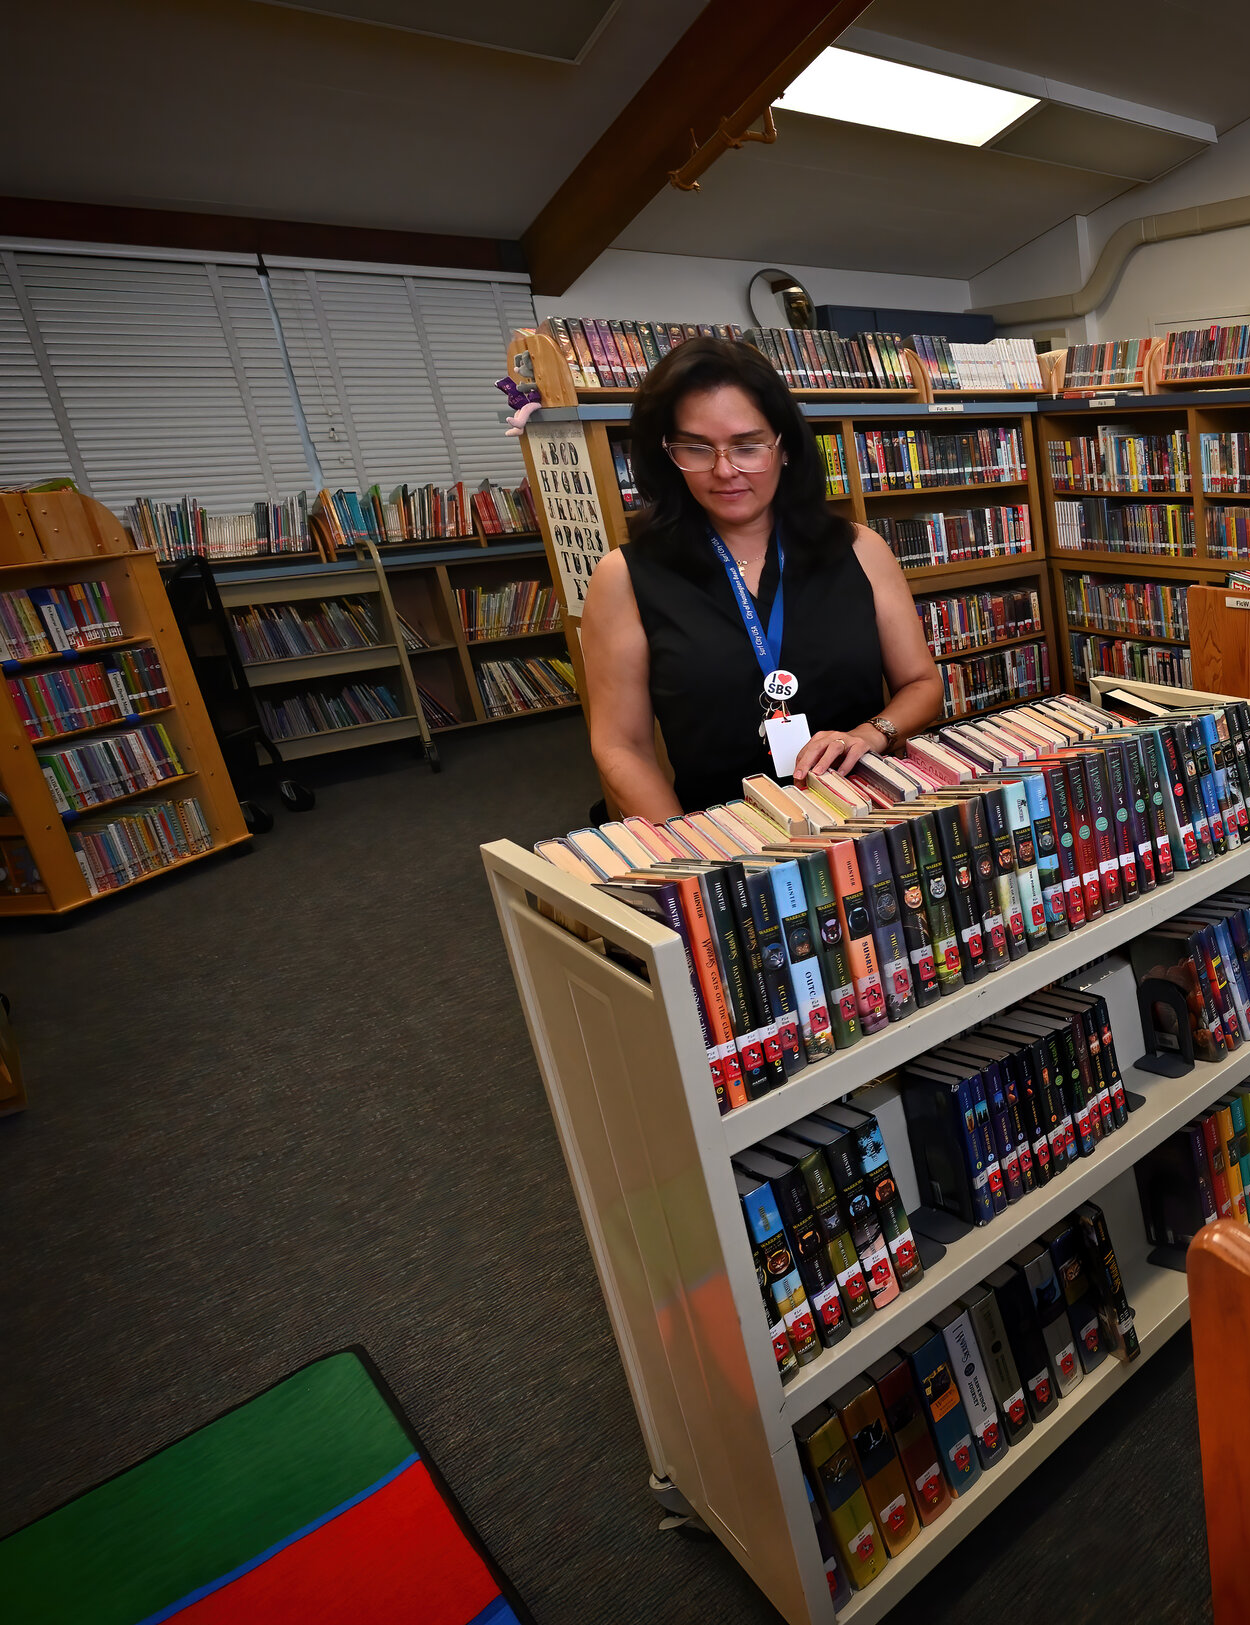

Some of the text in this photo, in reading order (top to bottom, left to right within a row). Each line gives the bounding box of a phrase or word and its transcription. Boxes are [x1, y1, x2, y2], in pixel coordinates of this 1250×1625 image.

[756, 644, 766, 656] Surf
[767, 683, 792, 696] SBS
[772, 673, 776, 682] I
[1097, 806, 1102, 814] 2
[926, 830, 935, 856] HUNTER
[952, 821, 961, 847] HUNTER
[873, 850, 883, 875] HUNTER
[901, 839, 910, 865] HUNTER
[818, 870, 829, 899] HUNTER
[846, 860, 856, 887] HUNTER
[693, 891, 704, 920] HUNTER
[714, 881, 726, 913] HUNTER
[736, 880, 748, 909] HUNTER
[759, 893, 770, 923] HUNTER
[785, 880, 798, 910] HUNTER
[668, 898, 681, 929] HUNTER
[861, 941, 874, 974] SUNRIS
[805, 971, 816, 998] OUTC
[777, 984, 790, 1013] ECLIP
[721, 1020, 732, 1043] CLAN
[841, 1151, 853, 1178] HUNTER
[813, 1168, 826, 1195] HUNTER
[851, 1299, 869, 1314] HARPER
